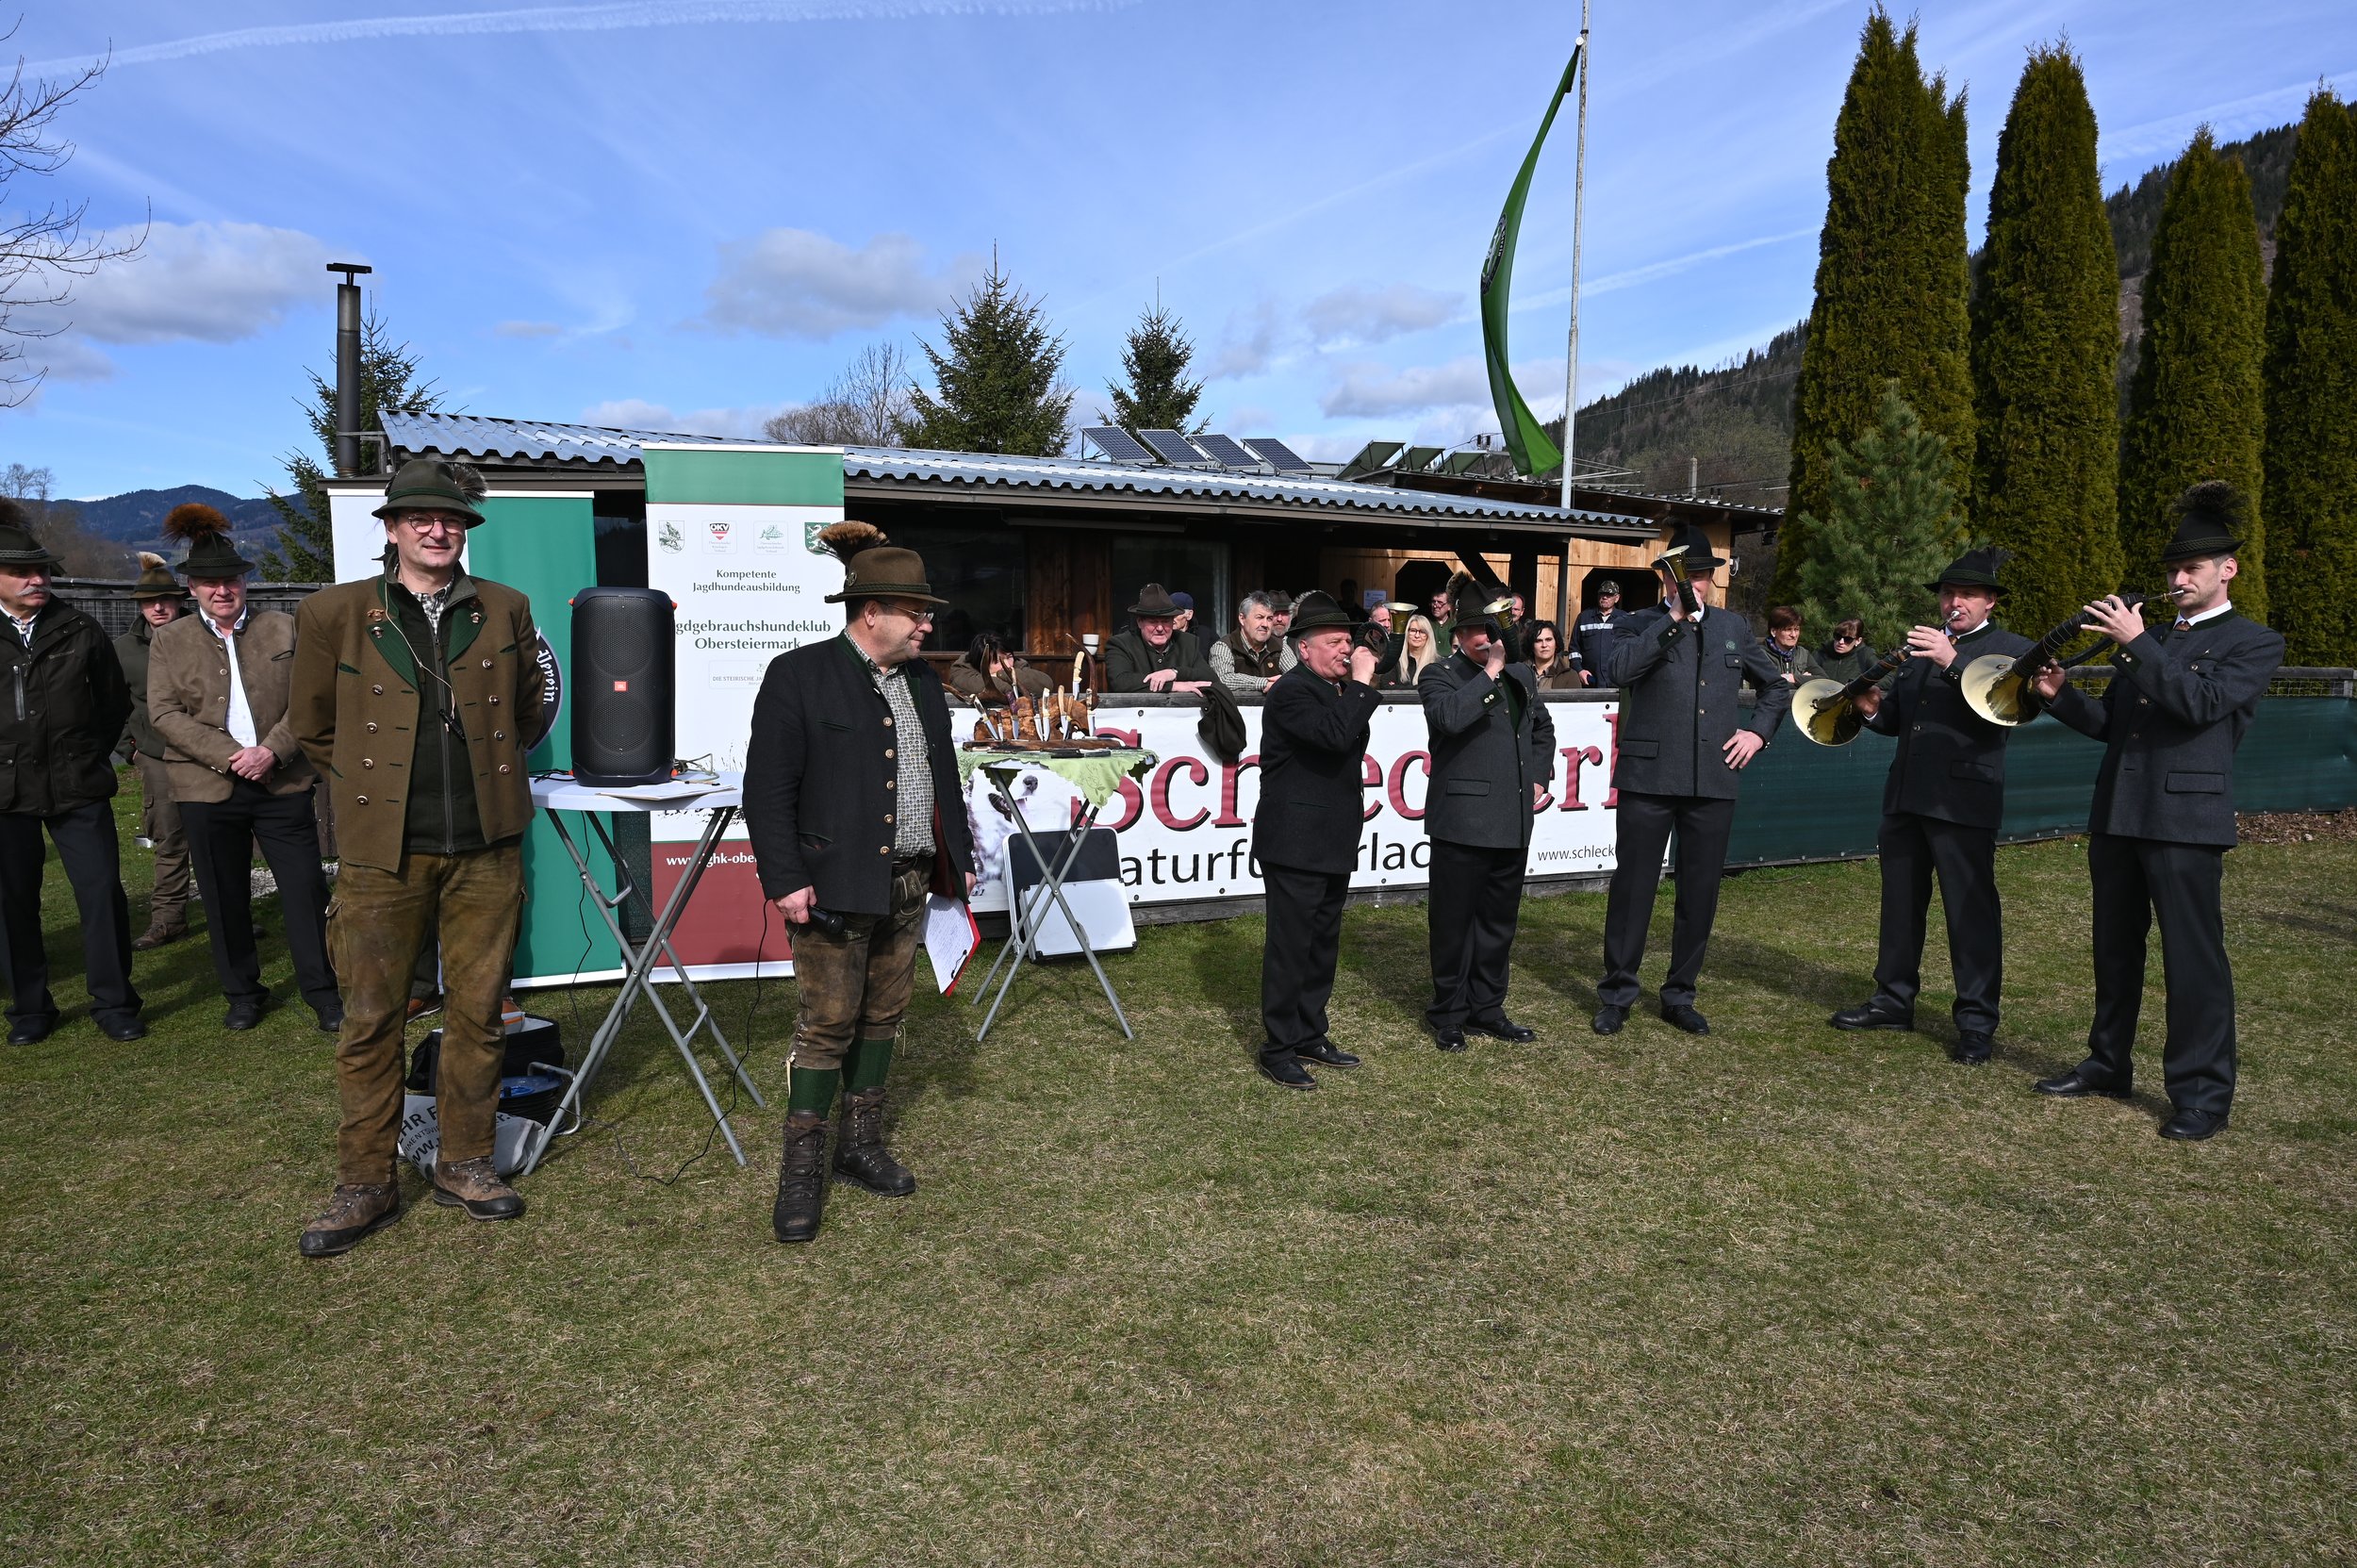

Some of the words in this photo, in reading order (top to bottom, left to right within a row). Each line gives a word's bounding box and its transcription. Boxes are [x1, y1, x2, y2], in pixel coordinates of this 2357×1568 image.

[717, 569, 777, 580] Kompetente
[693, 582, 800, 594] Jagdhundeausbildung
[676, 619, 832, 635] gdgebrauchshundeklub
[695, 637, 801, 650] Obersteiermark
[1538, 844, 1615, 862] www.schleck
